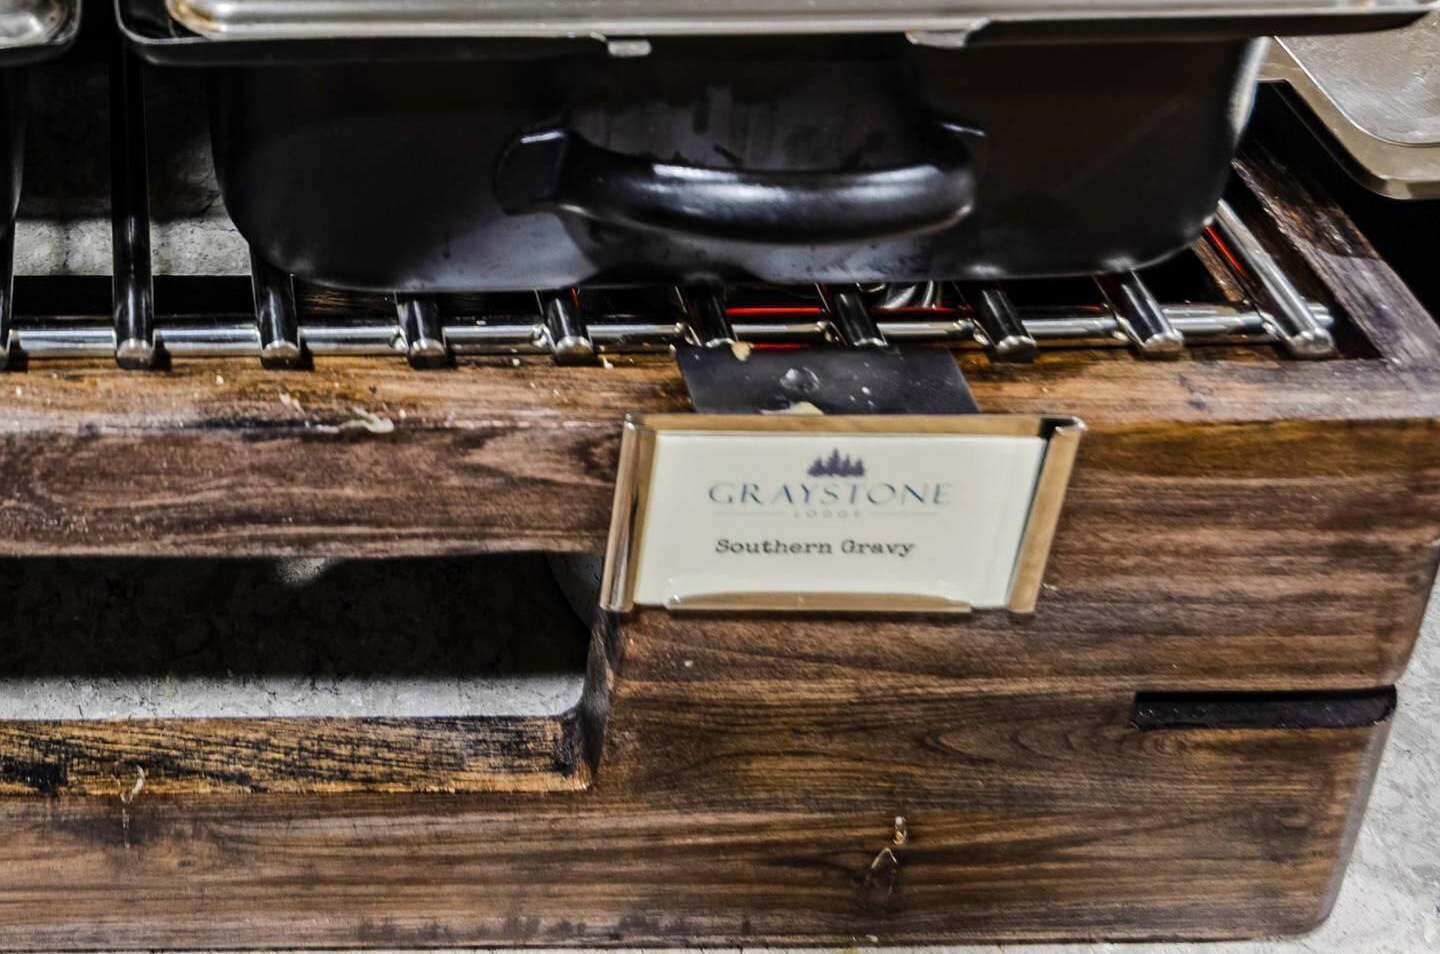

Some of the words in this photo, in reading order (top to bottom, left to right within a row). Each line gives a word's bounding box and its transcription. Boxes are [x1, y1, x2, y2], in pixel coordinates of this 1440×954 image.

[708, 483, 953, 505] GRAYSTONE
[714, 538, 833, 554] Southern
[840, 538, 915, 558] Gravy
